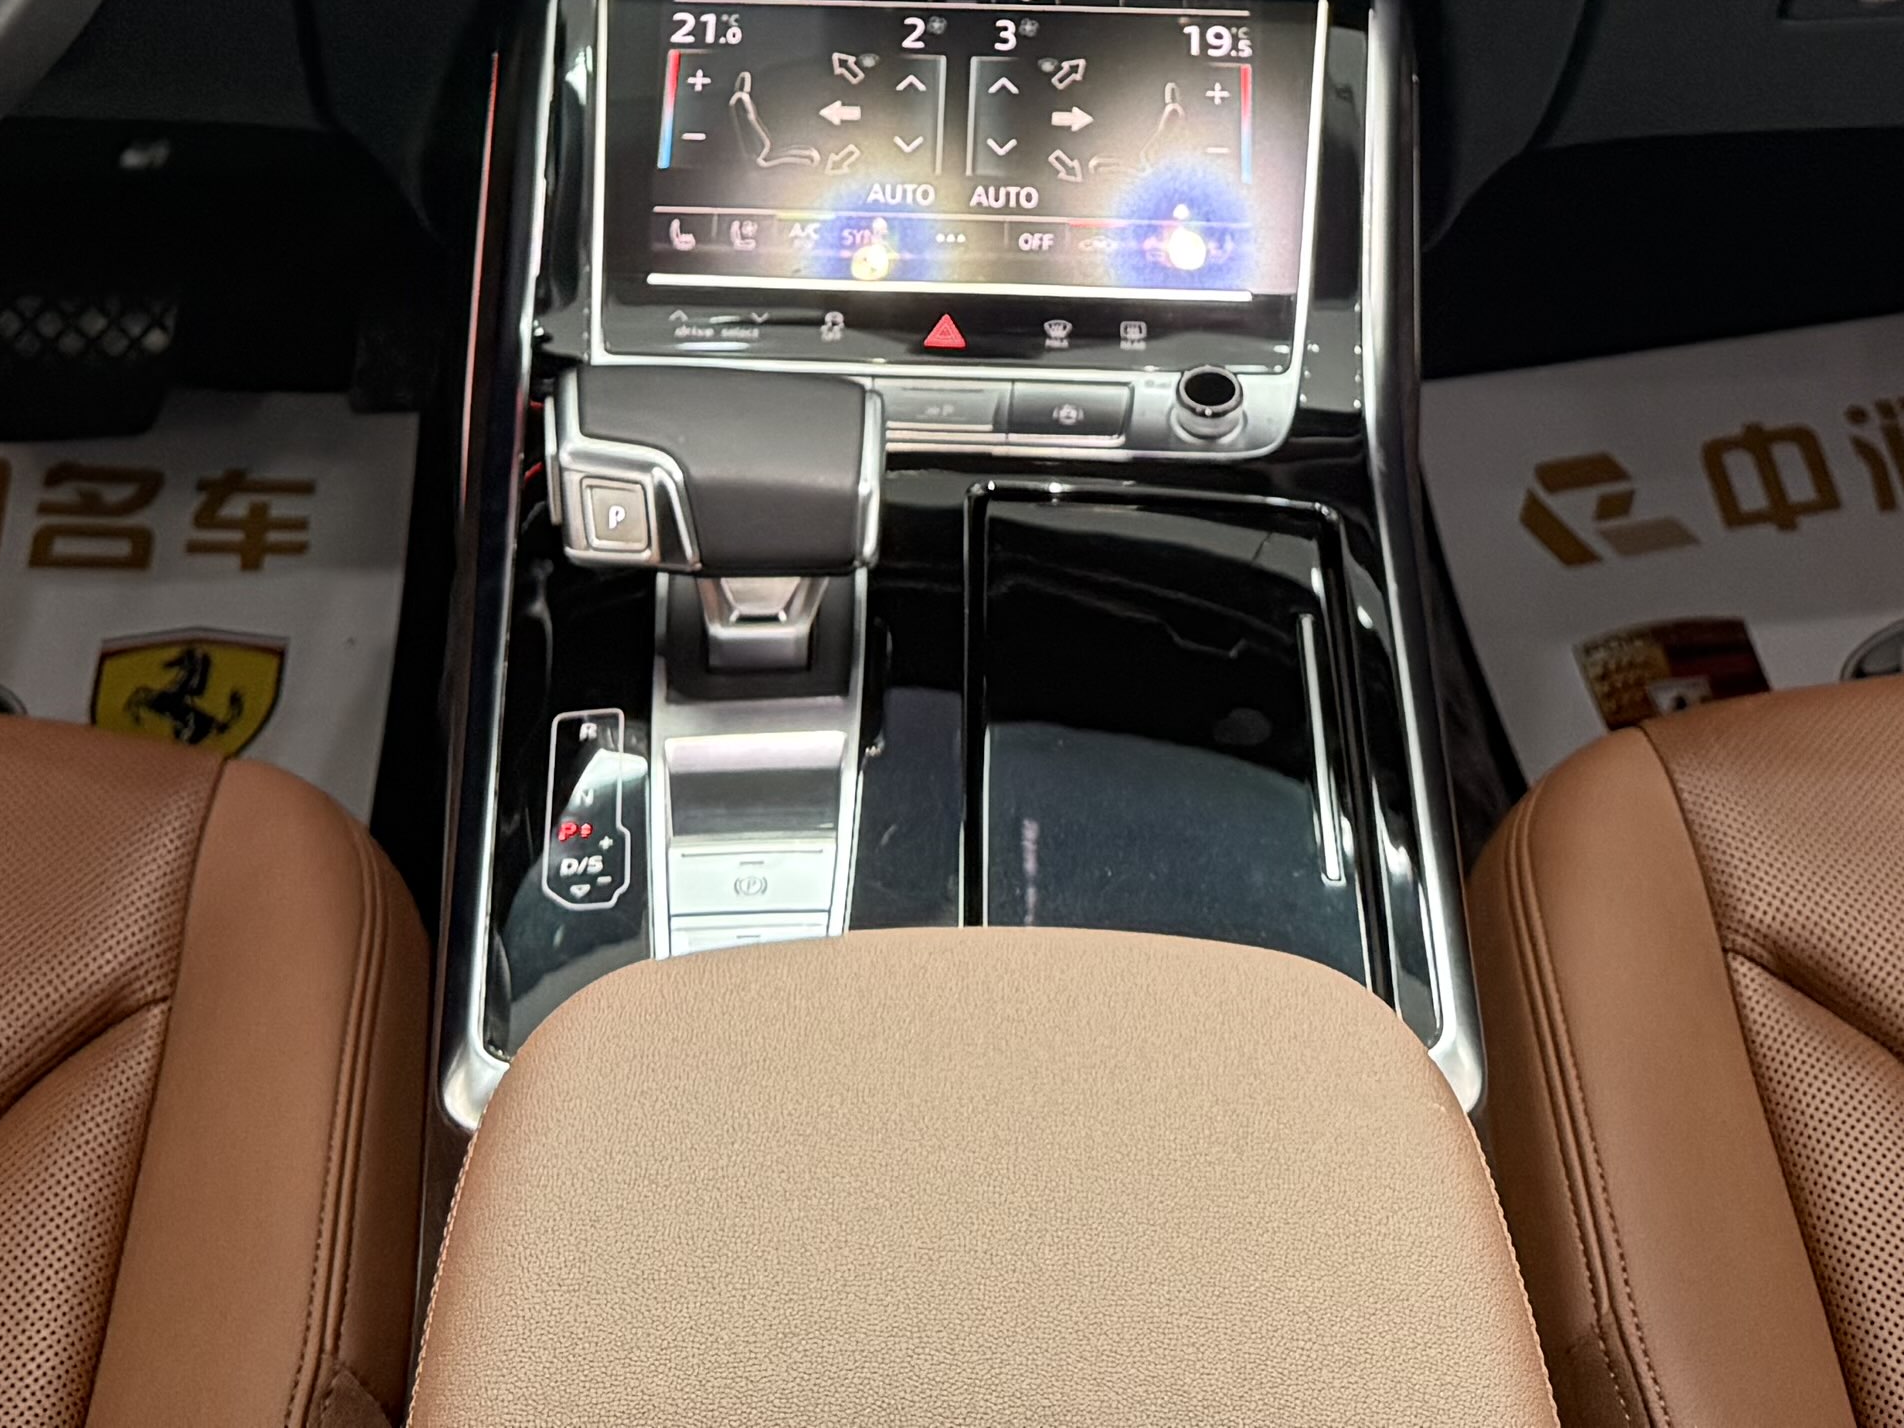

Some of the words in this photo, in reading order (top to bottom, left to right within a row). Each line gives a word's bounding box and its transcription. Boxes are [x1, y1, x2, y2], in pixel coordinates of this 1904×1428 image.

[670, 12, 743, 45] 21.0
[900, 17, 927, 49] 2
[993, 19, 1017, 52] 3
[1182, 25, 1254, 58] 19.5
[866, 182, 937, 206] AUTO
[969, 186, 1040, 209] AUTO
[1018, 232, 1055, 252] OFF
[608, 504, 627, 530] P
[578, 723, 598, 742] R
[575, 788, 596, 807] N
[557, 822, 578, 843] P
[559, 855, 604, 877] D/S
